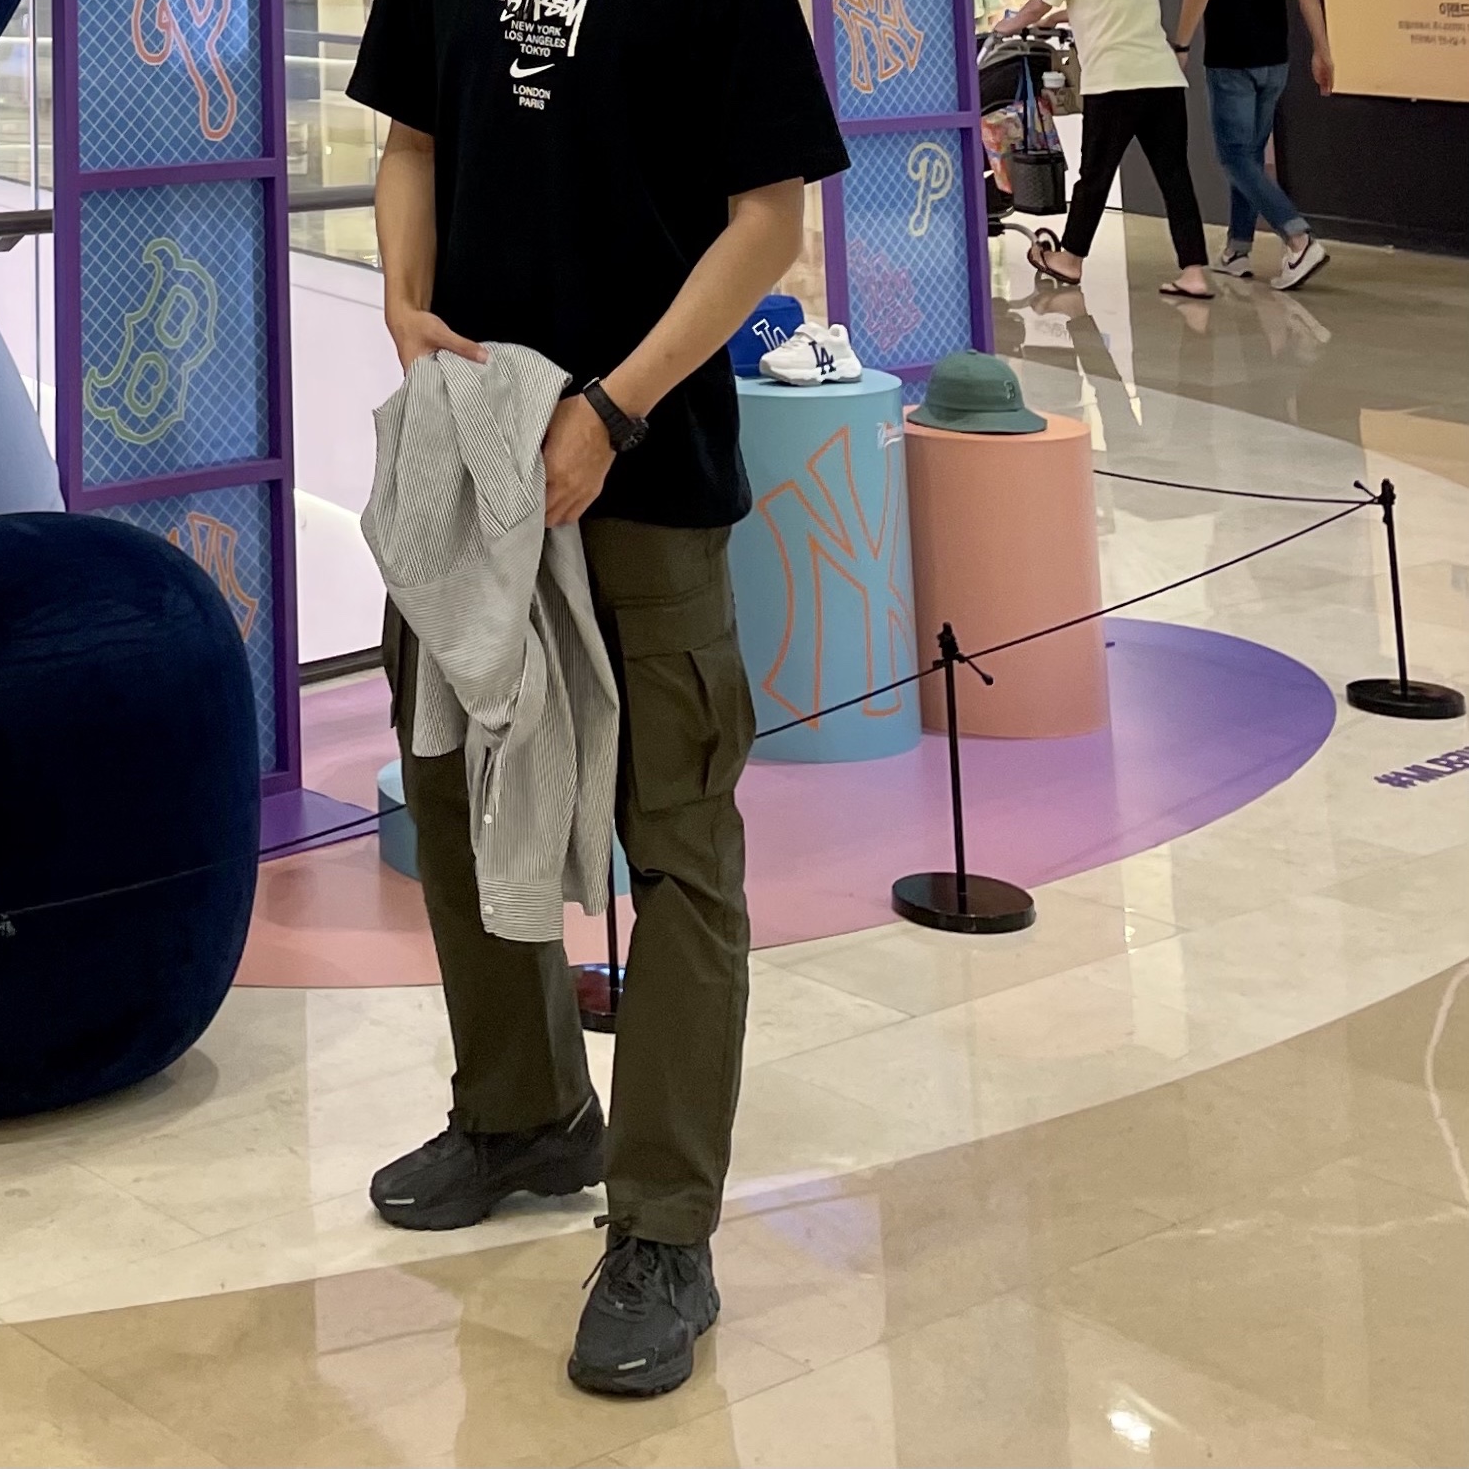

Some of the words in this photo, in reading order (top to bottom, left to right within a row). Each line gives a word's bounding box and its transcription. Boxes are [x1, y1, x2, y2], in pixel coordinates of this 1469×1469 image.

[510, 19, 534, 32] NEW
[536, 23, 562, 36] YORK
[504, 30, 524, 42] LOS
[525, 33, 567, 48] ANGELES
[520, 43, 551, 57] TOKYO
[513, 84, 551, 99] LONDON
[519, 96, 545, 110] PARIS
[808, 339, 837, 376] LA
